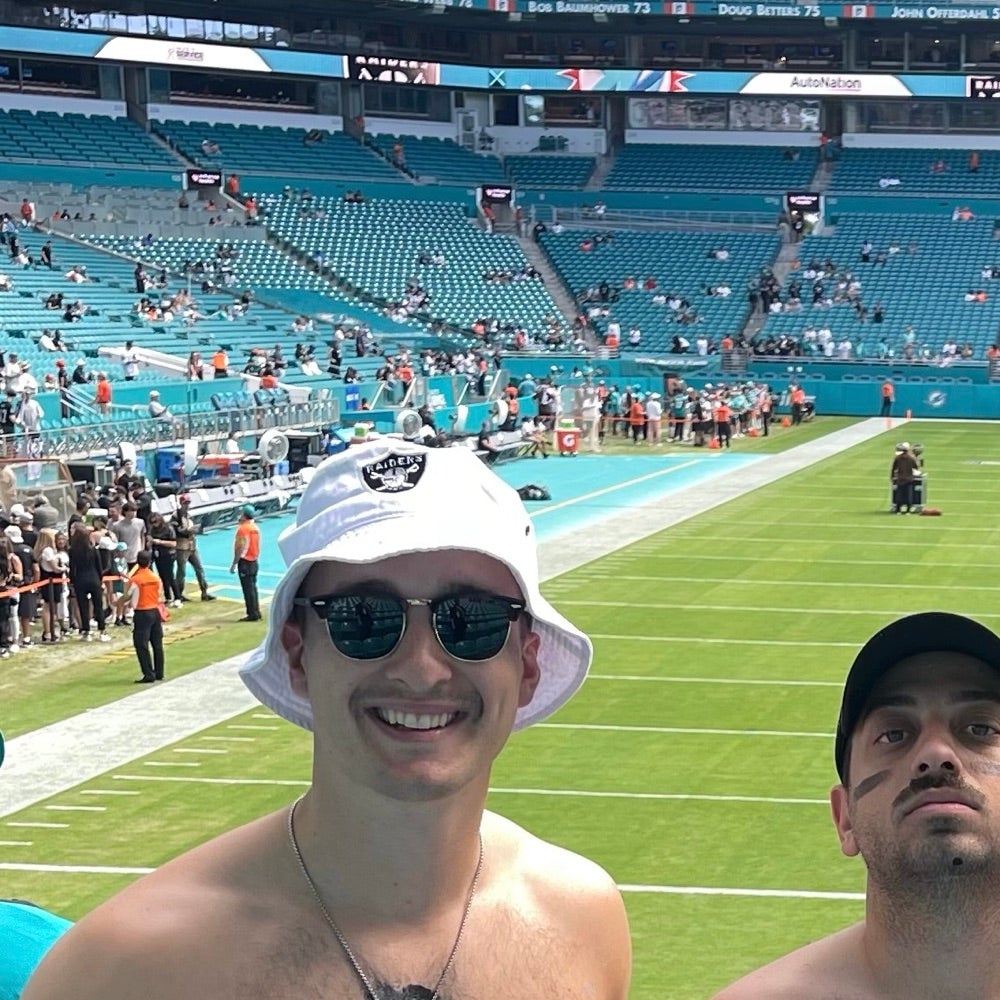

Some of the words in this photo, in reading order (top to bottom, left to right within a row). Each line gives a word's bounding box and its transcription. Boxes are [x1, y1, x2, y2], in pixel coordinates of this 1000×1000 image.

[634, 2, 651, 14] 73
[804, 5, 821, 17] 75
[790, 77, 862, 89] AutoNation
[366, 455, 422, 474] RAIDERS
